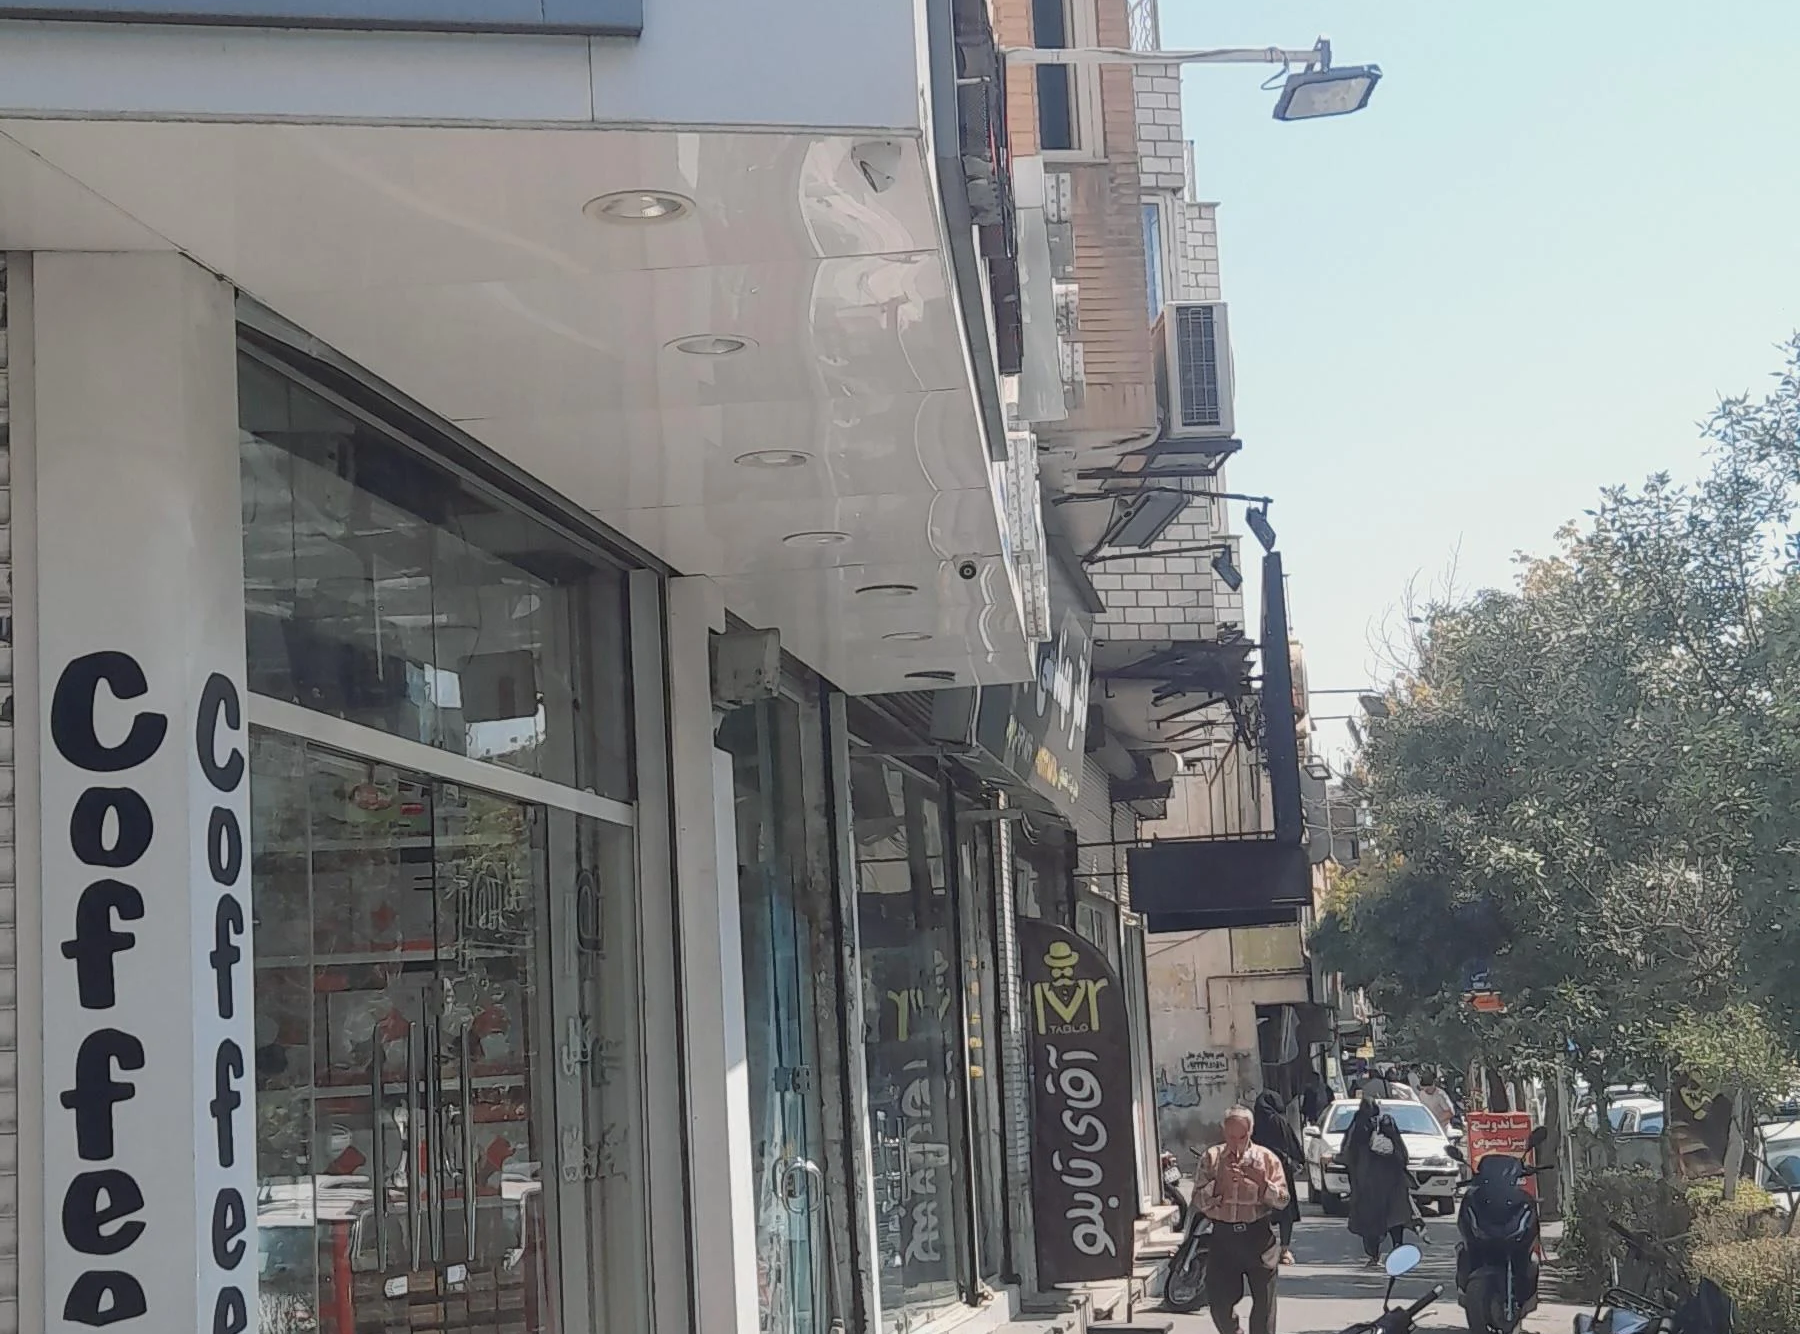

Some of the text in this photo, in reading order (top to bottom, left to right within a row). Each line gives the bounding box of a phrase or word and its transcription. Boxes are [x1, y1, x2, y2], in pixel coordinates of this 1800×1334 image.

[1050, 1022, 1089, 1035] TABLO
[1045, 1043, 1120, 1258] آقای تابلو
